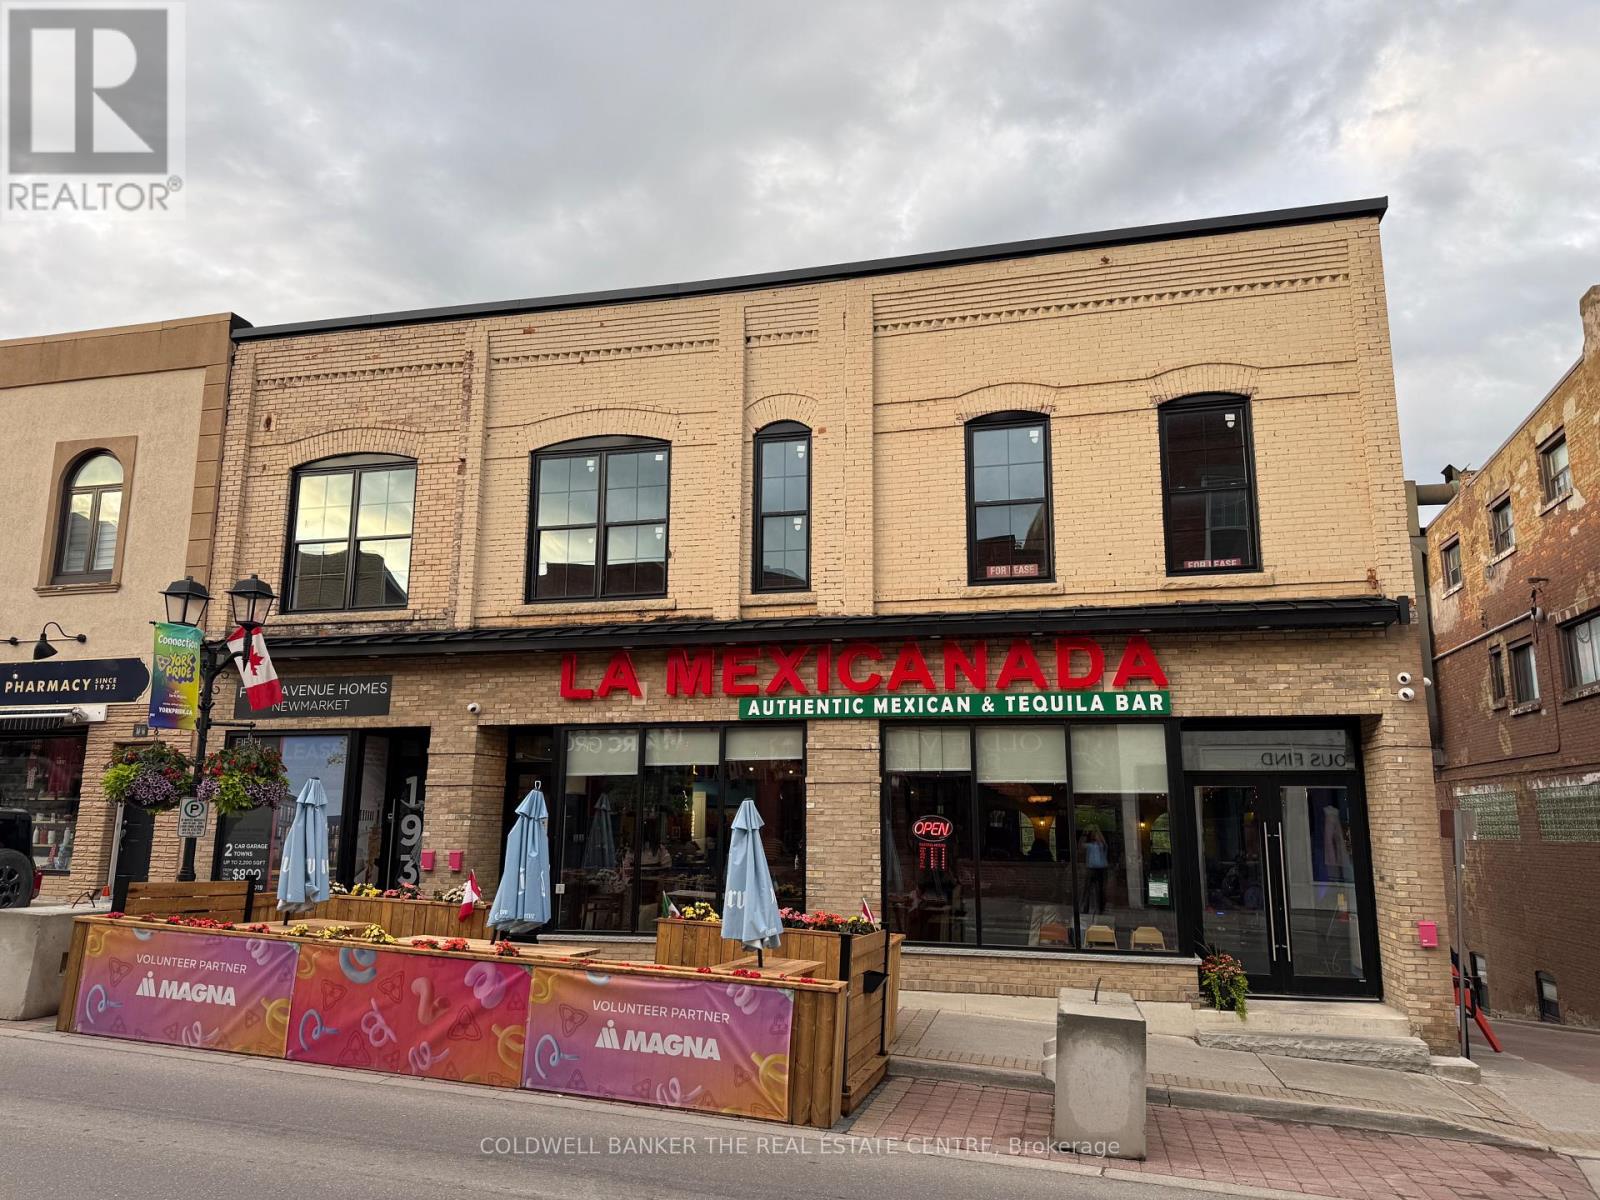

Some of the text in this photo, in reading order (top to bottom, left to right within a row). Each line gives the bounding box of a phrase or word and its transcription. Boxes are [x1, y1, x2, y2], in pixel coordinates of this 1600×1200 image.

[990, 565, 1007, 575] FOR
[158, 633, 198, 650] Connection
[169, 652, 195, 669] YORK
[560, 636, 1169, 699] LA MEXICANADA
[94, 676, 118, 684] SINCE
[166, 665, 193, 679] PRIDE
[4, 678, 92, 693] PHARMACY
[94, 683, 117, 691] 1932
[281, 681, 388, 697] AVENUE HOMES
[271, 699, 350, 712] NEWMARKET
[748, 693, 1164, 716] AUTHENTIC MEXICAN & TEQUILA BAR
[190, 804, 199, 814] P
[914, 821, 950, 837] OPEN
[224, 843, 233, 857] 2
[136, 953, 247, 975] VOLUNTEER PARTNER
[158, 979, 236, 1007] MAGNA
[592, 999, 730, 1025] VOLUNTEER PARTNER
[622, 1029, 721, 1061] MAGNA
